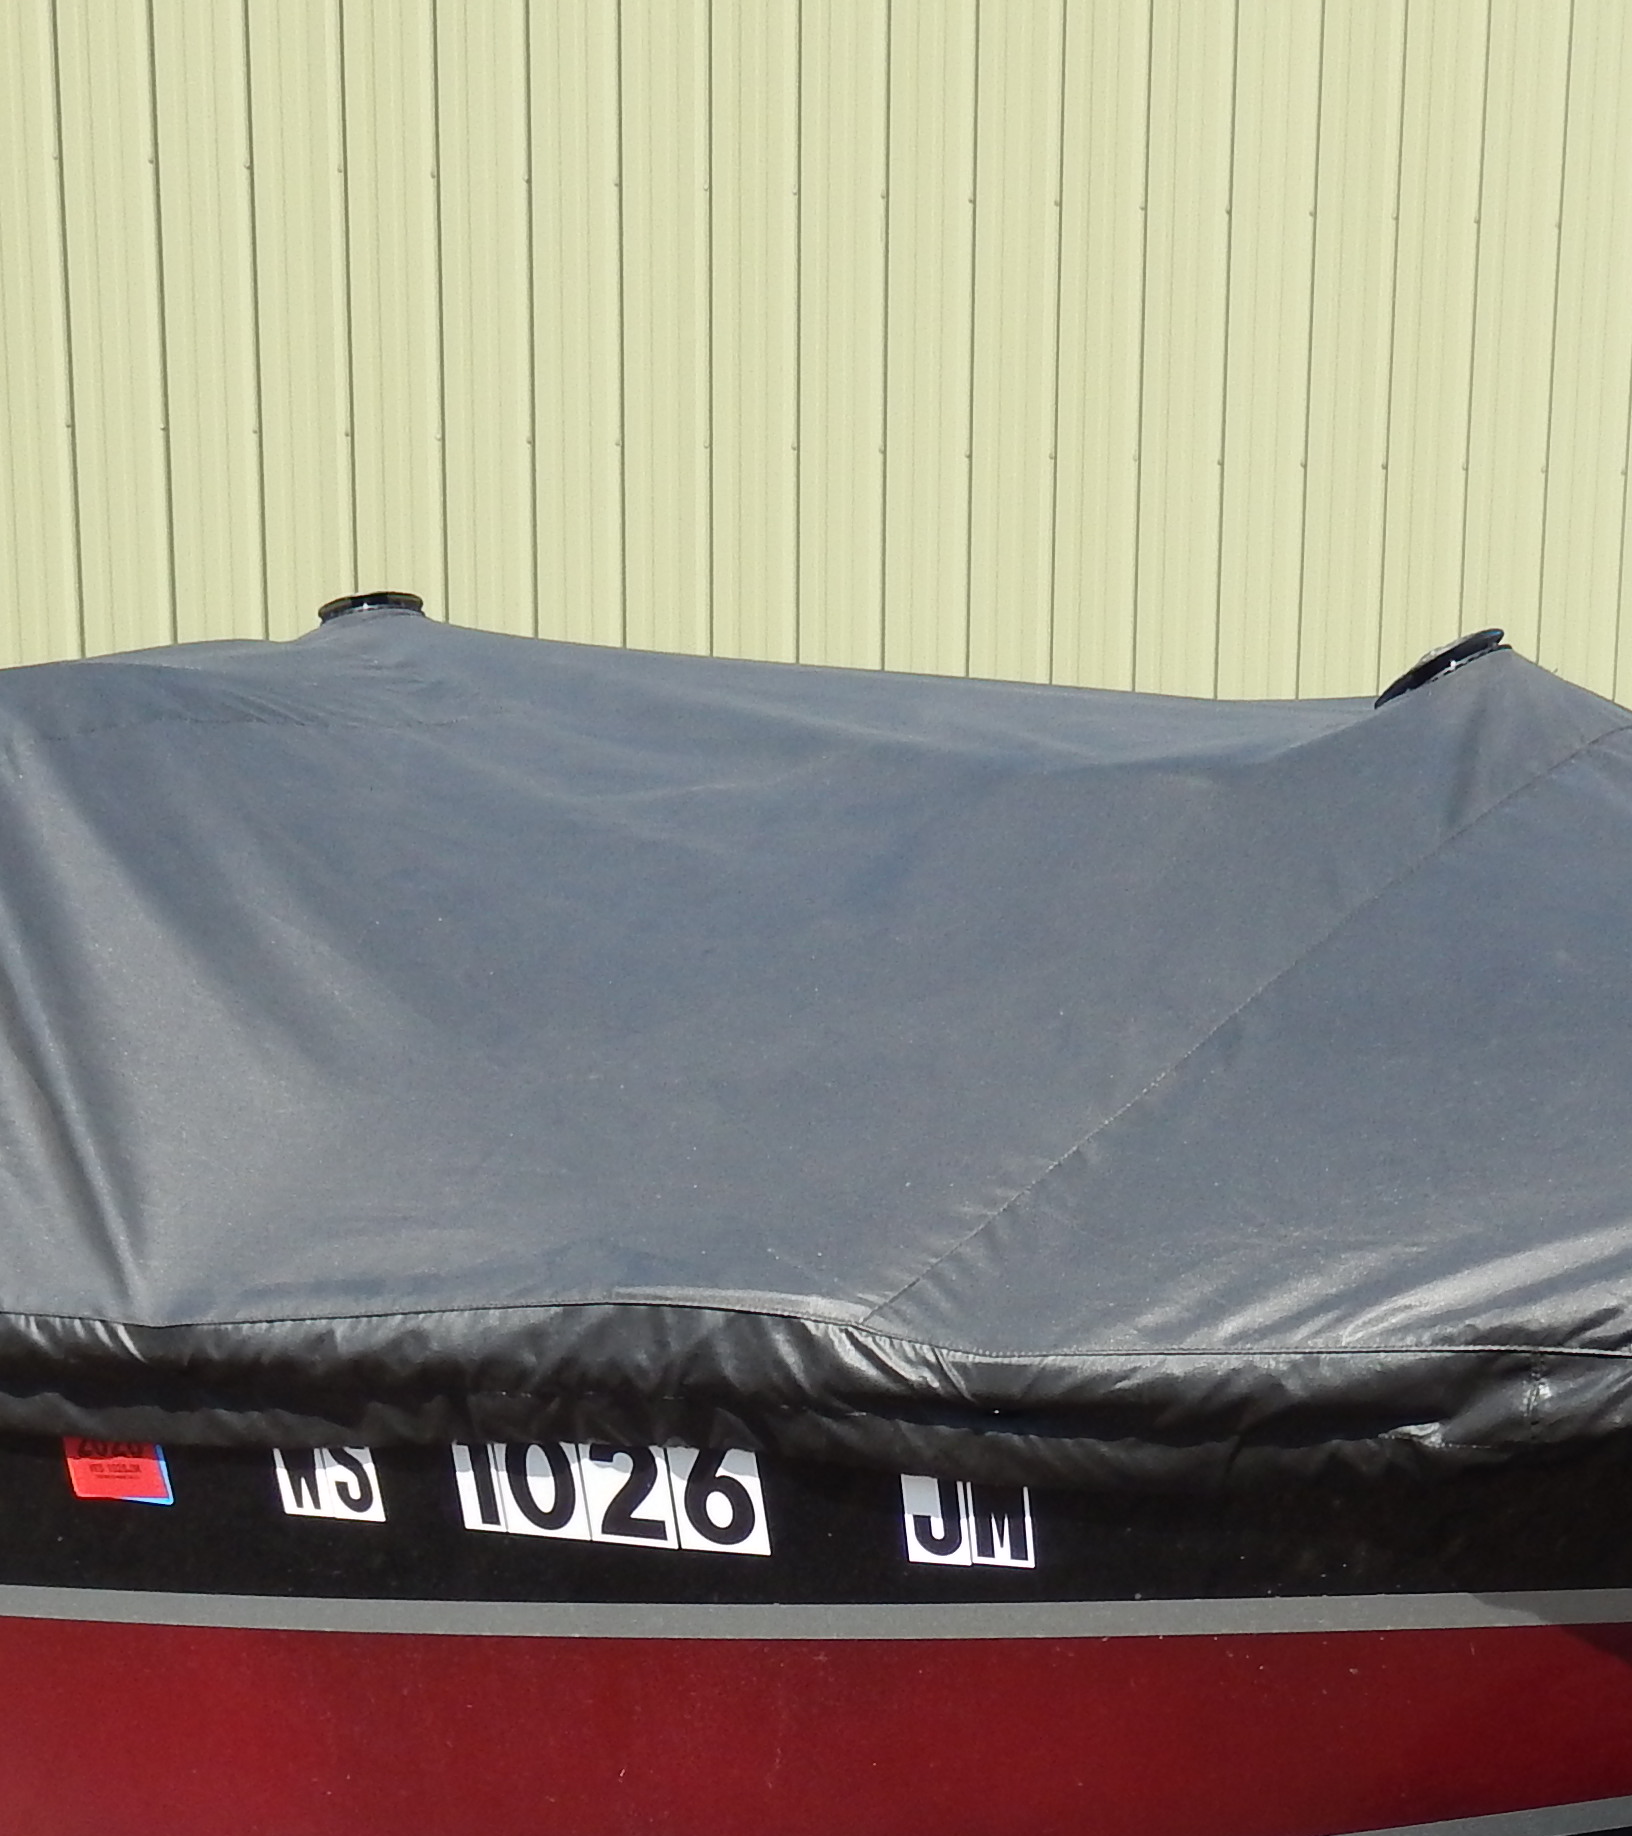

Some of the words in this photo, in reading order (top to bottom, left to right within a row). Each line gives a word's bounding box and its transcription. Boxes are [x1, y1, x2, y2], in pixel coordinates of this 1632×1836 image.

[277, 1446, 375, 1513] WS
[467, 1443, 756, 1546] 1026
[912, 1480, 1029, 1562] JM
